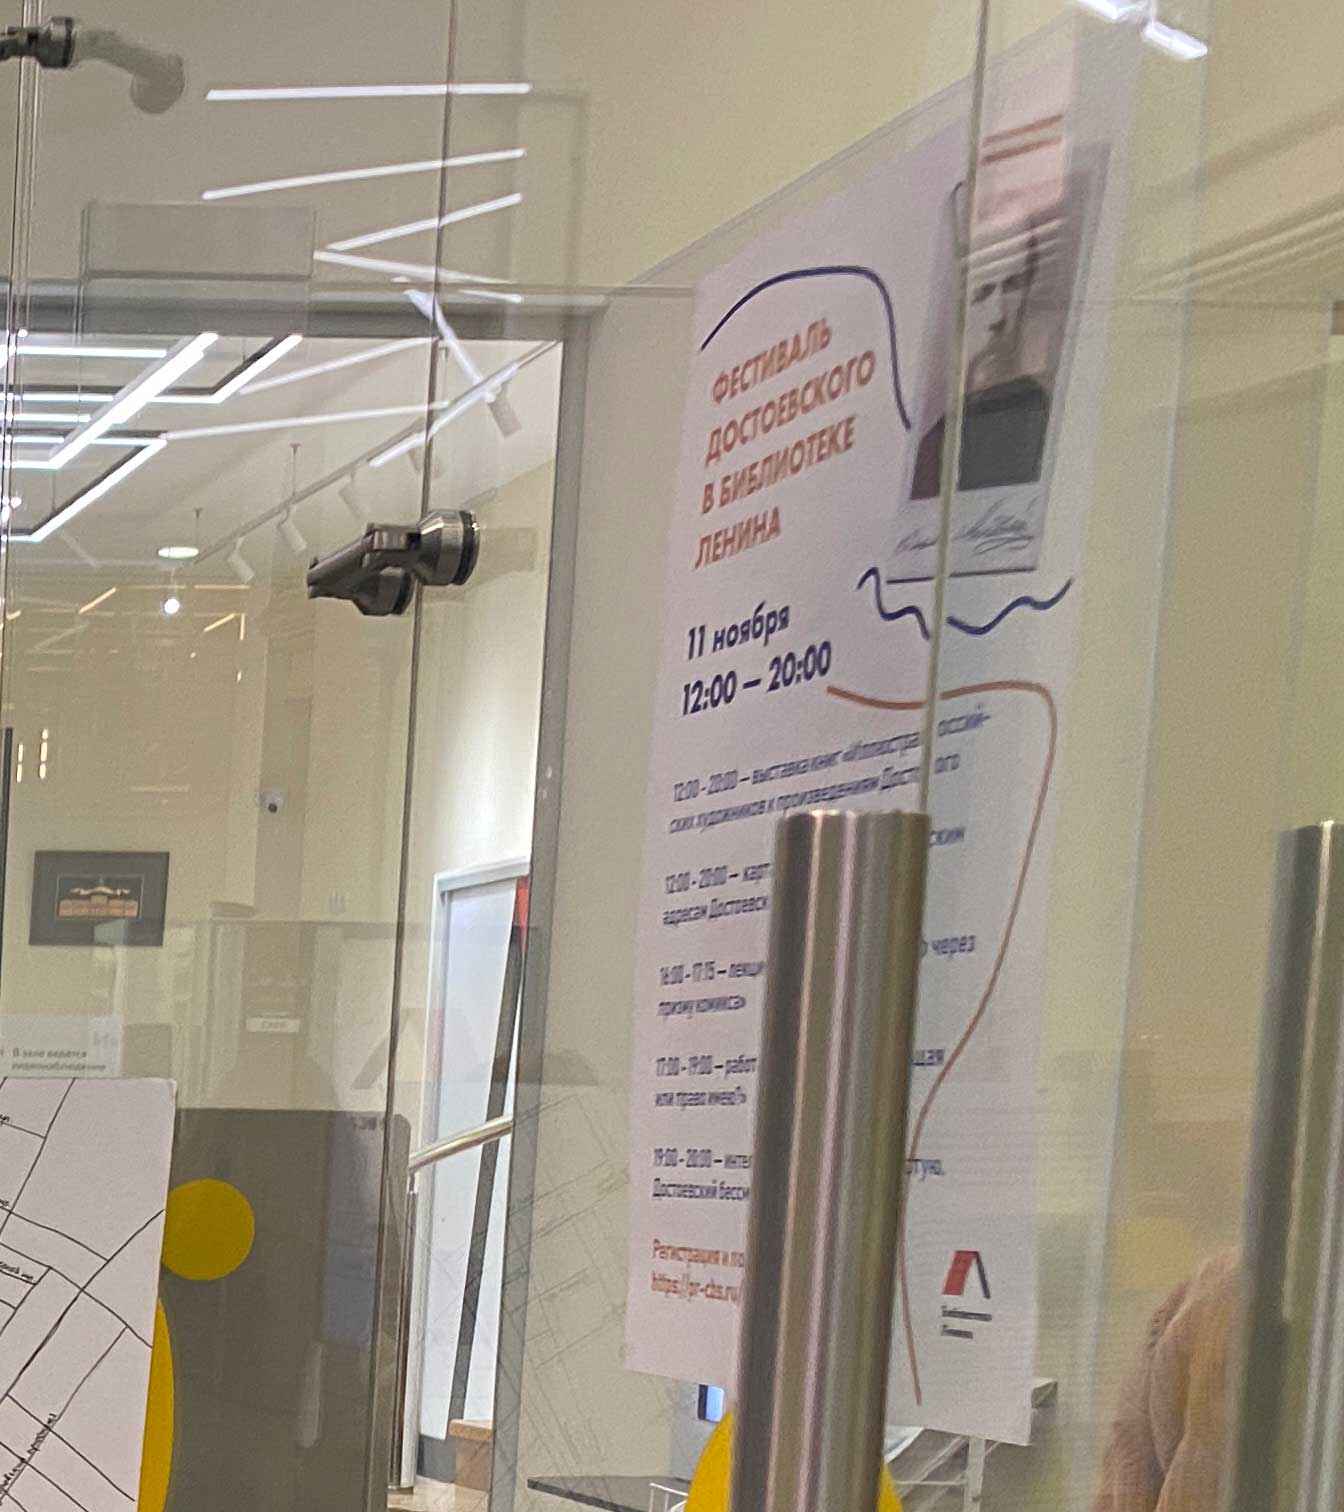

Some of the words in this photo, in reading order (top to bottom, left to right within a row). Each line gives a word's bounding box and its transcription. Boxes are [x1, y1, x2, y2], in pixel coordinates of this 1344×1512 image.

[712, 318, 832, 405] ФЕСТИВАЛЬ
[705, 351, 876, 468] ДОСТОЕВСКОГО
[701, 481, 714, 515] В
[719, 415, 857, 508] БИБЛИОТЕКЕ
[694, 505, 781, 570] ЛЕНИНА
[688, 624, 705, 660] 11
[712, 600, 790, 652] ноября
[682, 670, 737, 716] 12:00
[767, 640, 832, 693] 20:00
